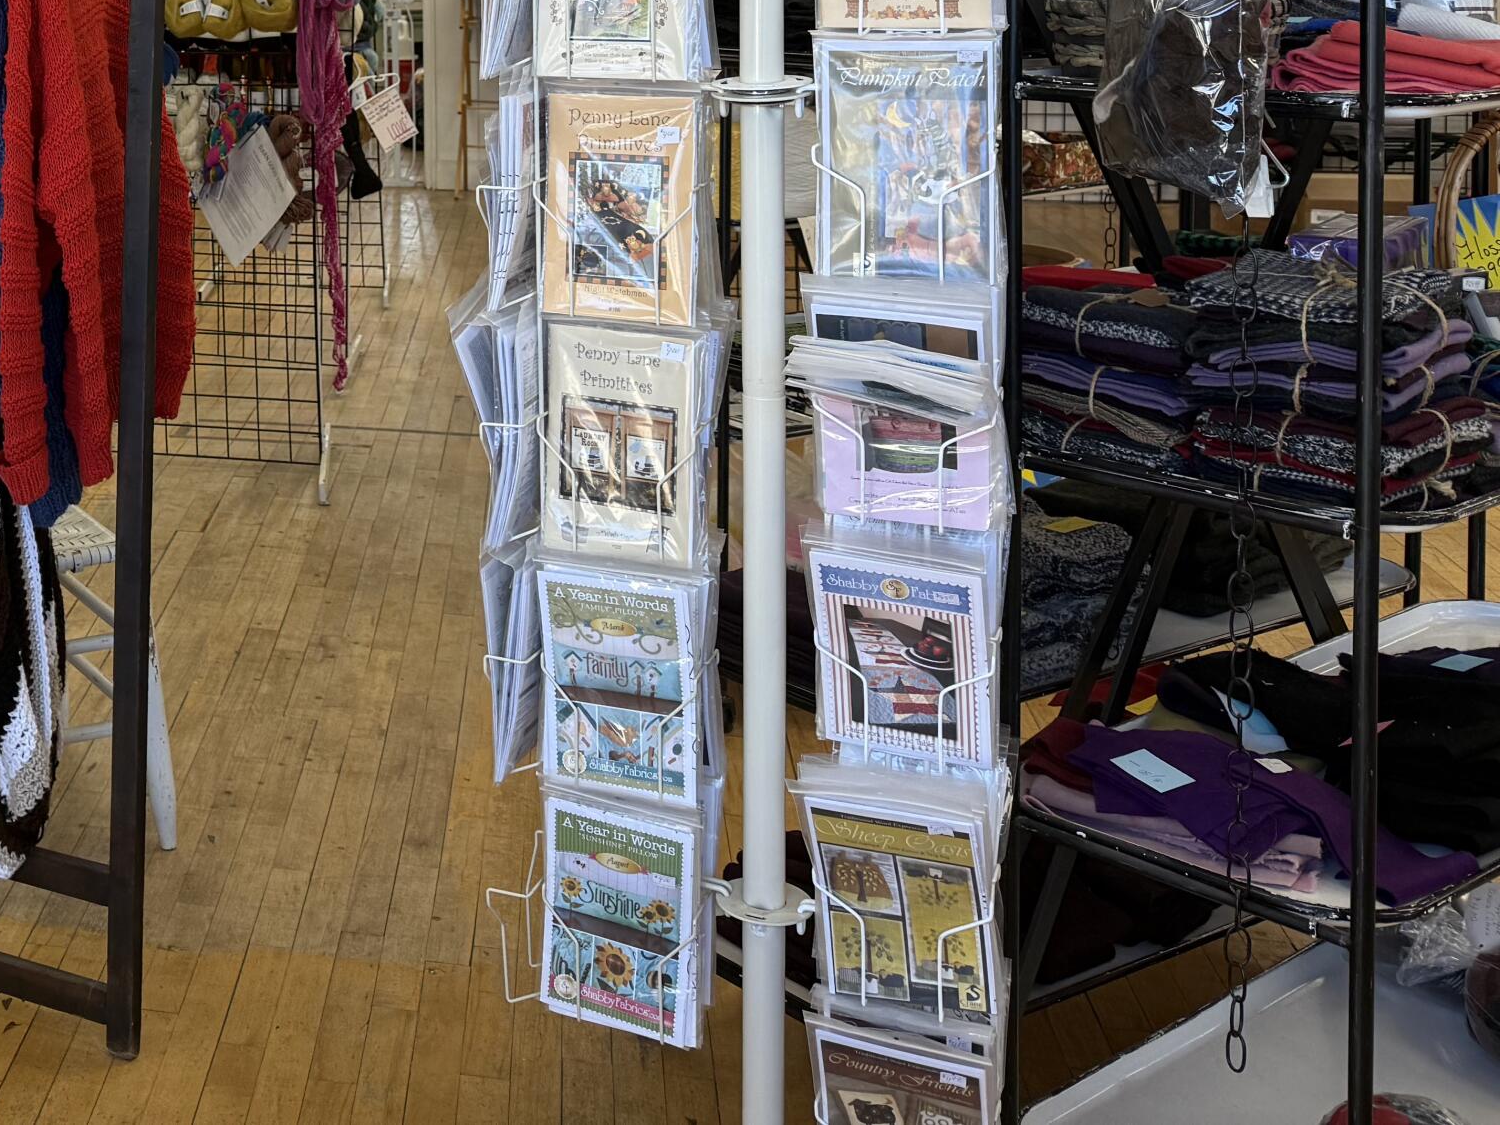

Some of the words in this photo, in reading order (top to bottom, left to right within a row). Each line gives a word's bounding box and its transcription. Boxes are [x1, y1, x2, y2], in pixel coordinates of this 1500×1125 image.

[836, 66, 921, 94] Pumpkin
[925, 64, 986, 88] Patch
[568, 108, 622, 129] Penny
[628, 111, 671, 128] Lane
[577, 133, 663, 154] Primitives
[574, 341, 621, 366] Penny
[627, 349, 661, 368] Lane
[580, 369, 653, 395] Primitives
[825, 573, 880, 594] Shabby
[553, 586, 566, 599] A
[568, 588, 602, 603] Year
[605, 592, 619, 605] in
[622, 595, 669, 613] Words
[582, 651, 629, 688] family
[562, 816, 574, 828] A
[578, 820, 610, 838] Year
[612, 827, 627, 842] in
[630, 832, 676, 856] Words
[814, 817, 895, 850] Sheep
[905, 833, 972, 859] Oasis
[606, 856, 630, 869] August
[579, 879, 643, 920] Sunshine
[828, 1051, 897, 1080] Country
